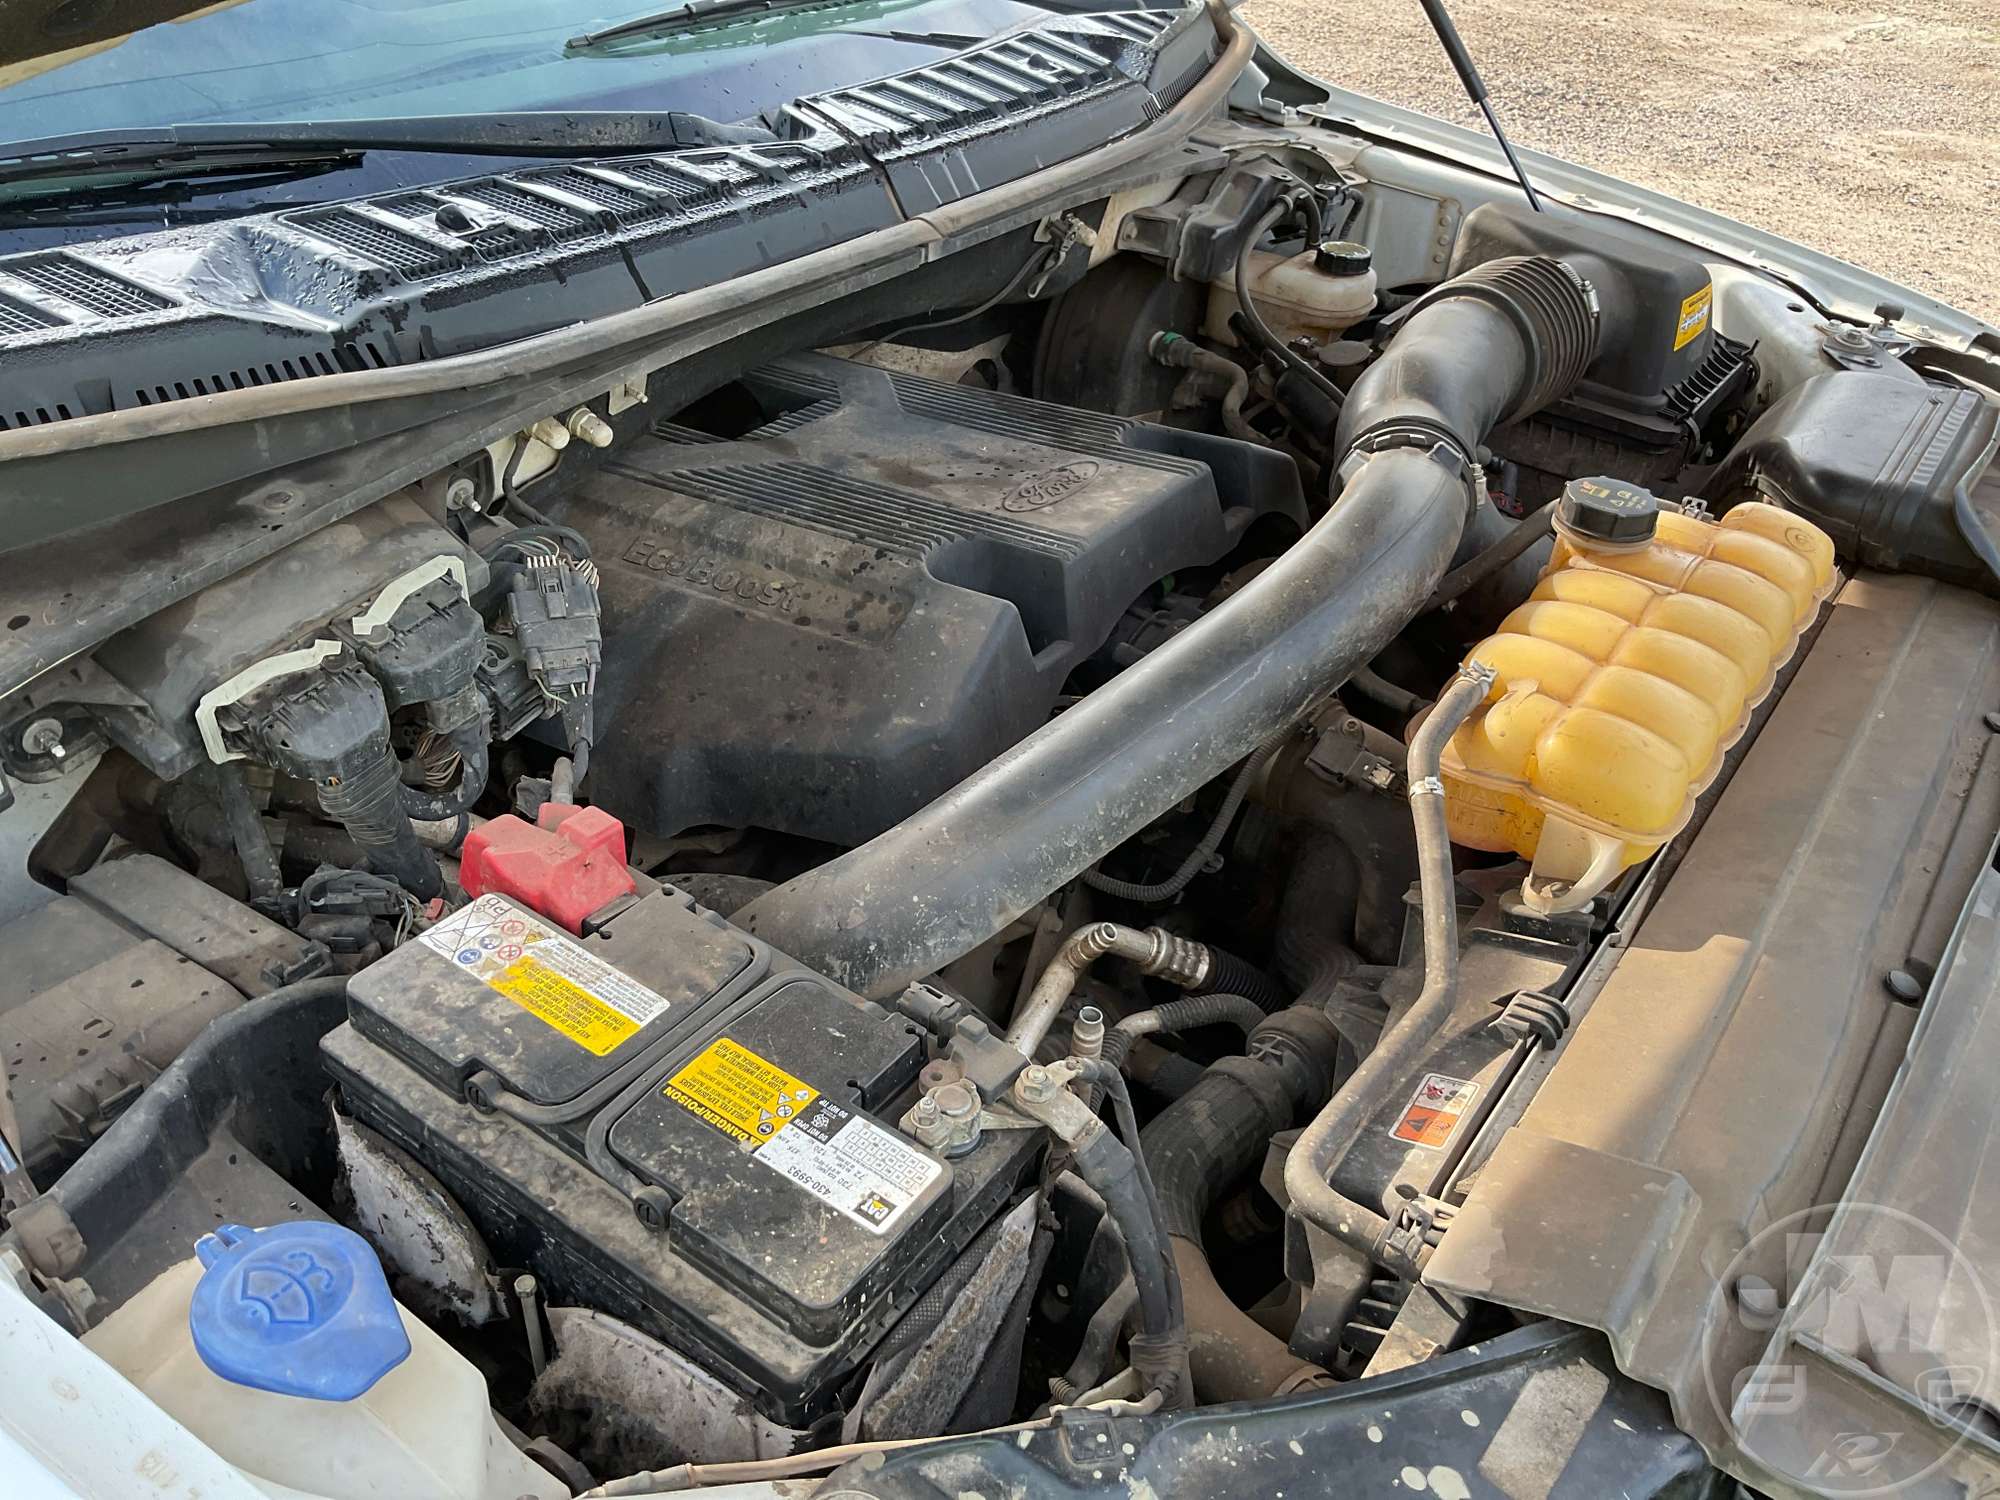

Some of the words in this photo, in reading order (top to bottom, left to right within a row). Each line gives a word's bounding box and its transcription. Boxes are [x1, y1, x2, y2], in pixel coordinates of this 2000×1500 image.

[1018, 468, 1088, 505] Ford
[478, 895, 513, 917] Pb
[817, 1098, 830, 1107] TIP
[825, 1103, 841, 1114] NOT
[662, 1083, 749, 1144] DANGER/POISON
[836, 1109, 849, 1118] DO
[792, 1117, 810, 1130] OPEN
[805, 1125, 821, 1136] NOT
[816, 1132, 829, 1141] DO
[785, 1164, 832, 1197] 430-5993
[853, 1170, 865, 1179] 72
[857, 1196, 891, 1221] CAT
